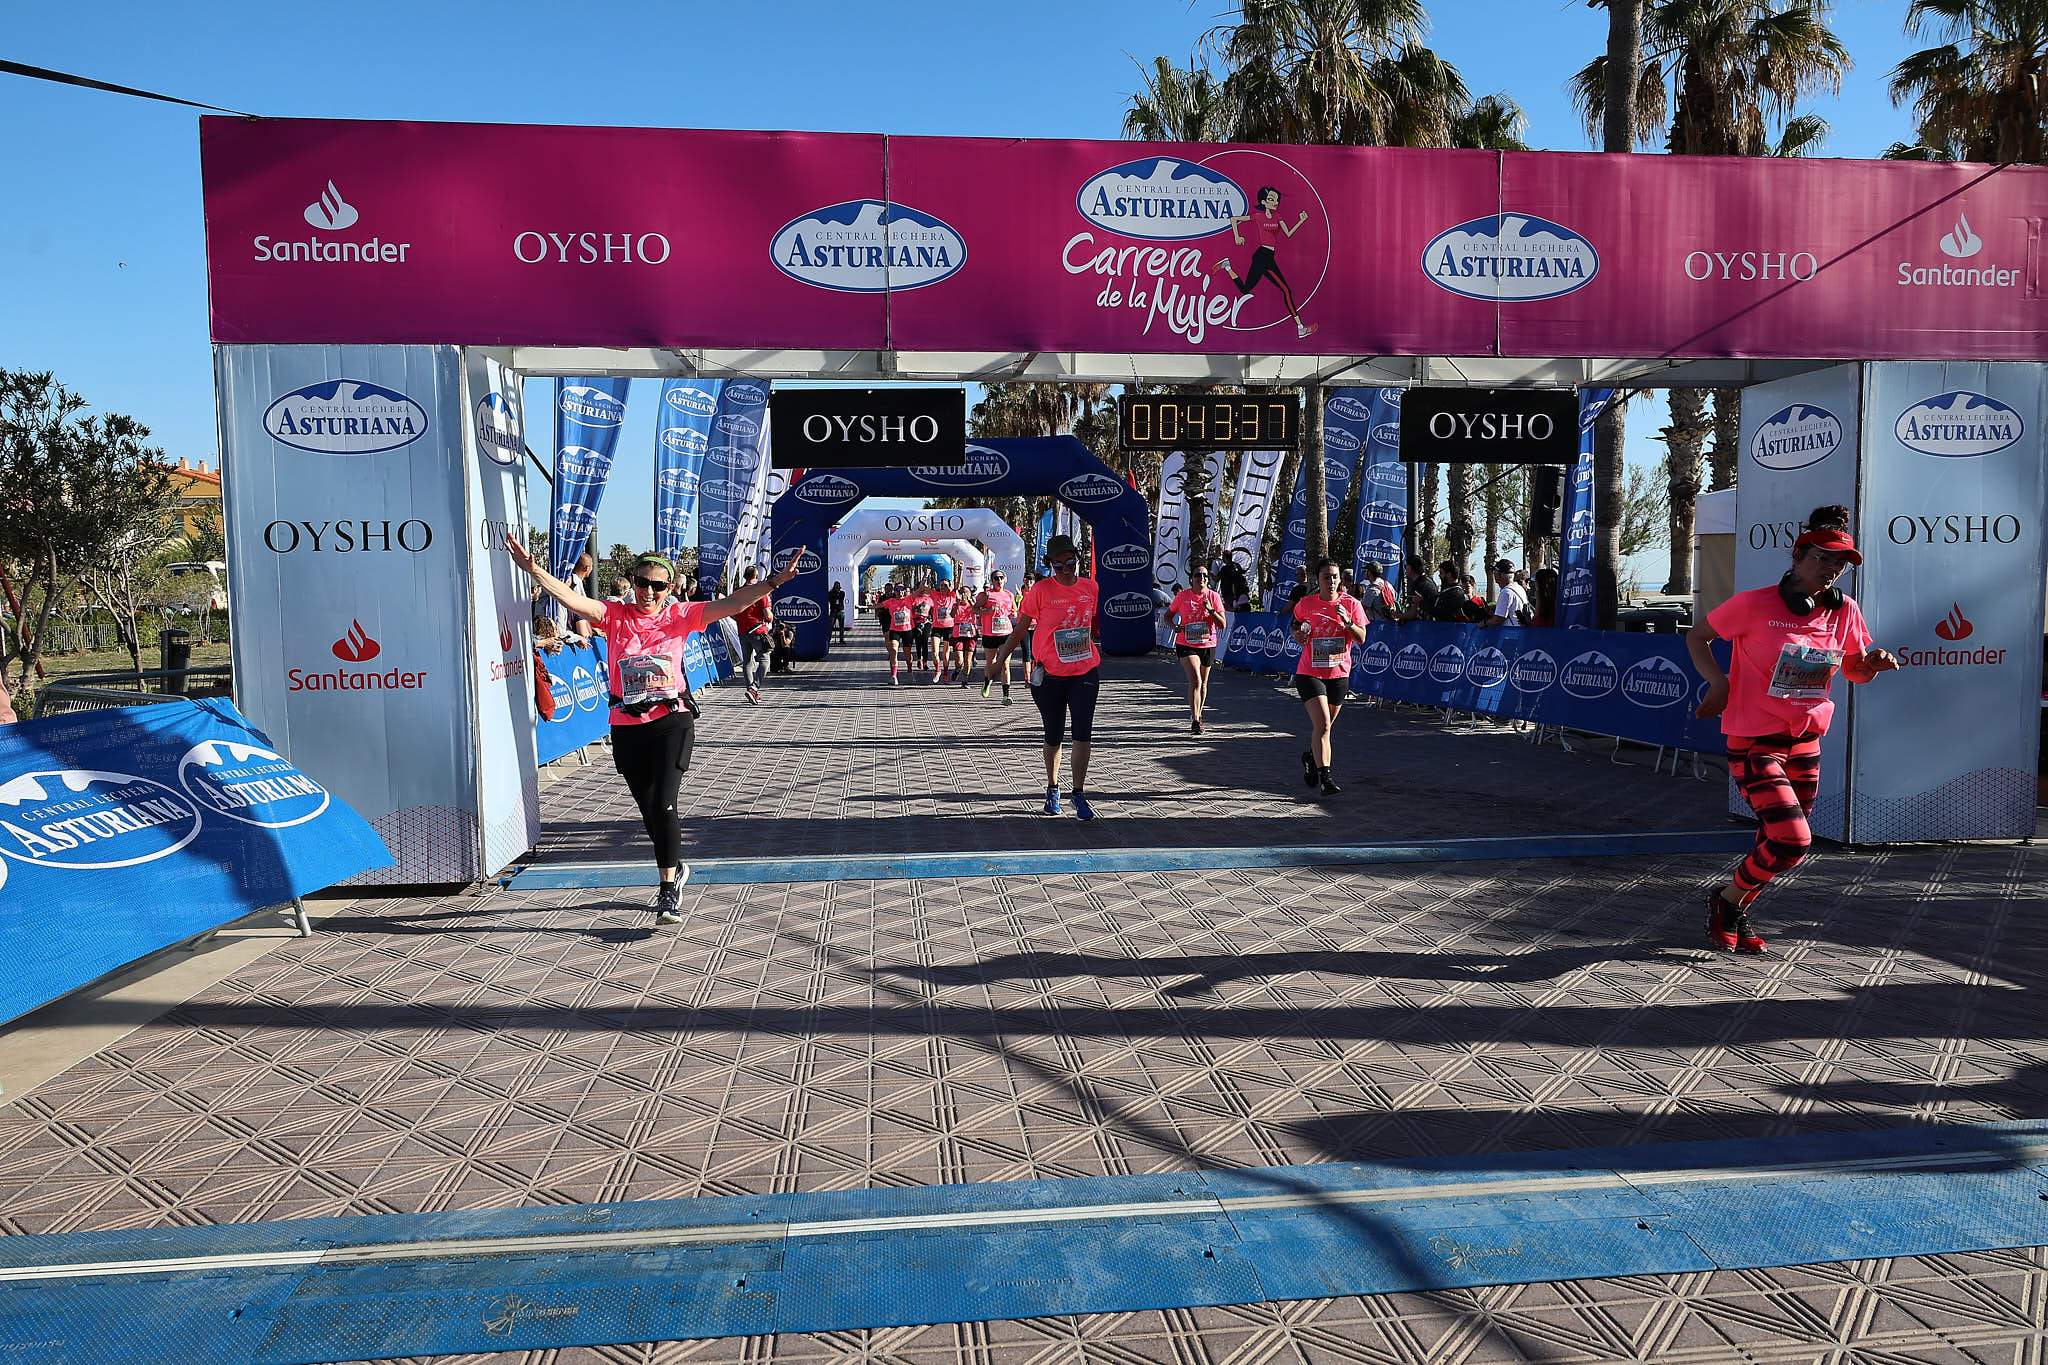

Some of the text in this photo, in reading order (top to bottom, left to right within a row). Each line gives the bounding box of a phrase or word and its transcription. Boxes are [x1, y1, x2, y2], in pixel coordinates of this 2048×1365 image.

[1090, 185, 1234, 220] ASTURIANA
[1116, 184, 1230, 195] CENTRAL LECHERA
[254, 235, 411, 264] Santander
[513, 231, 671, 265] OYSHO
[815, 231, 877, 241] CENTRAL
[1463, 243, 1580, 253] CENTRAL LECHERA
[786, 233, 952, 268] ASTURIANA
[1062, 232, 1202, 277] Carrera
[1435, 244, 1585, 278] ASTURIANA
[1684, 250, 1818, 282] OYSHO
[1898, 261, 2020, 288] Santander
[1096, 273, 1255, 344] de la Mujer
[276, 407, 416, 436] ASTURIANA
[301, 405, 410, 413] CENTRAL LECHERA
[1133, 404, 1286, 441] 00:43:37
[803, 414, 939, 444] OYSHO
[1429, 411, 1554, 441] OYSHO
[1903, 415, 2013, 441] ASTURIANA
[1325, 434, 1357, 449] STURIANA
[1756, 430, 1835, 457] ASTURIANA
[799, 486, 855, 498] ASTURIANA
[1064, 485, 1120, 498] ASTURIANA
[263, 518, 433, 553] OYSHO
[884, 515, 964, 532] OYSHO
[1750, 521, 1804, 549] OYS
[1888, 513, 2021, 545] OYSHO
[1897, 645, 2007, 667] Santander
[288, 667, 427, 692] Santander
[1512, 664, 1553, 682] ASTURIANA
[1563, 671, 1613, 689] ASTURIANA
[1624, 672, 1681, 698] ASTURIANA
[208, 768, 252, 781] CENTRAL
[21, 784, 156, 821] CENTRAL LECHERA
[195, 774, 323, 810] ASTURIANA
[0, 796, 193, 858] ASTURIANA
